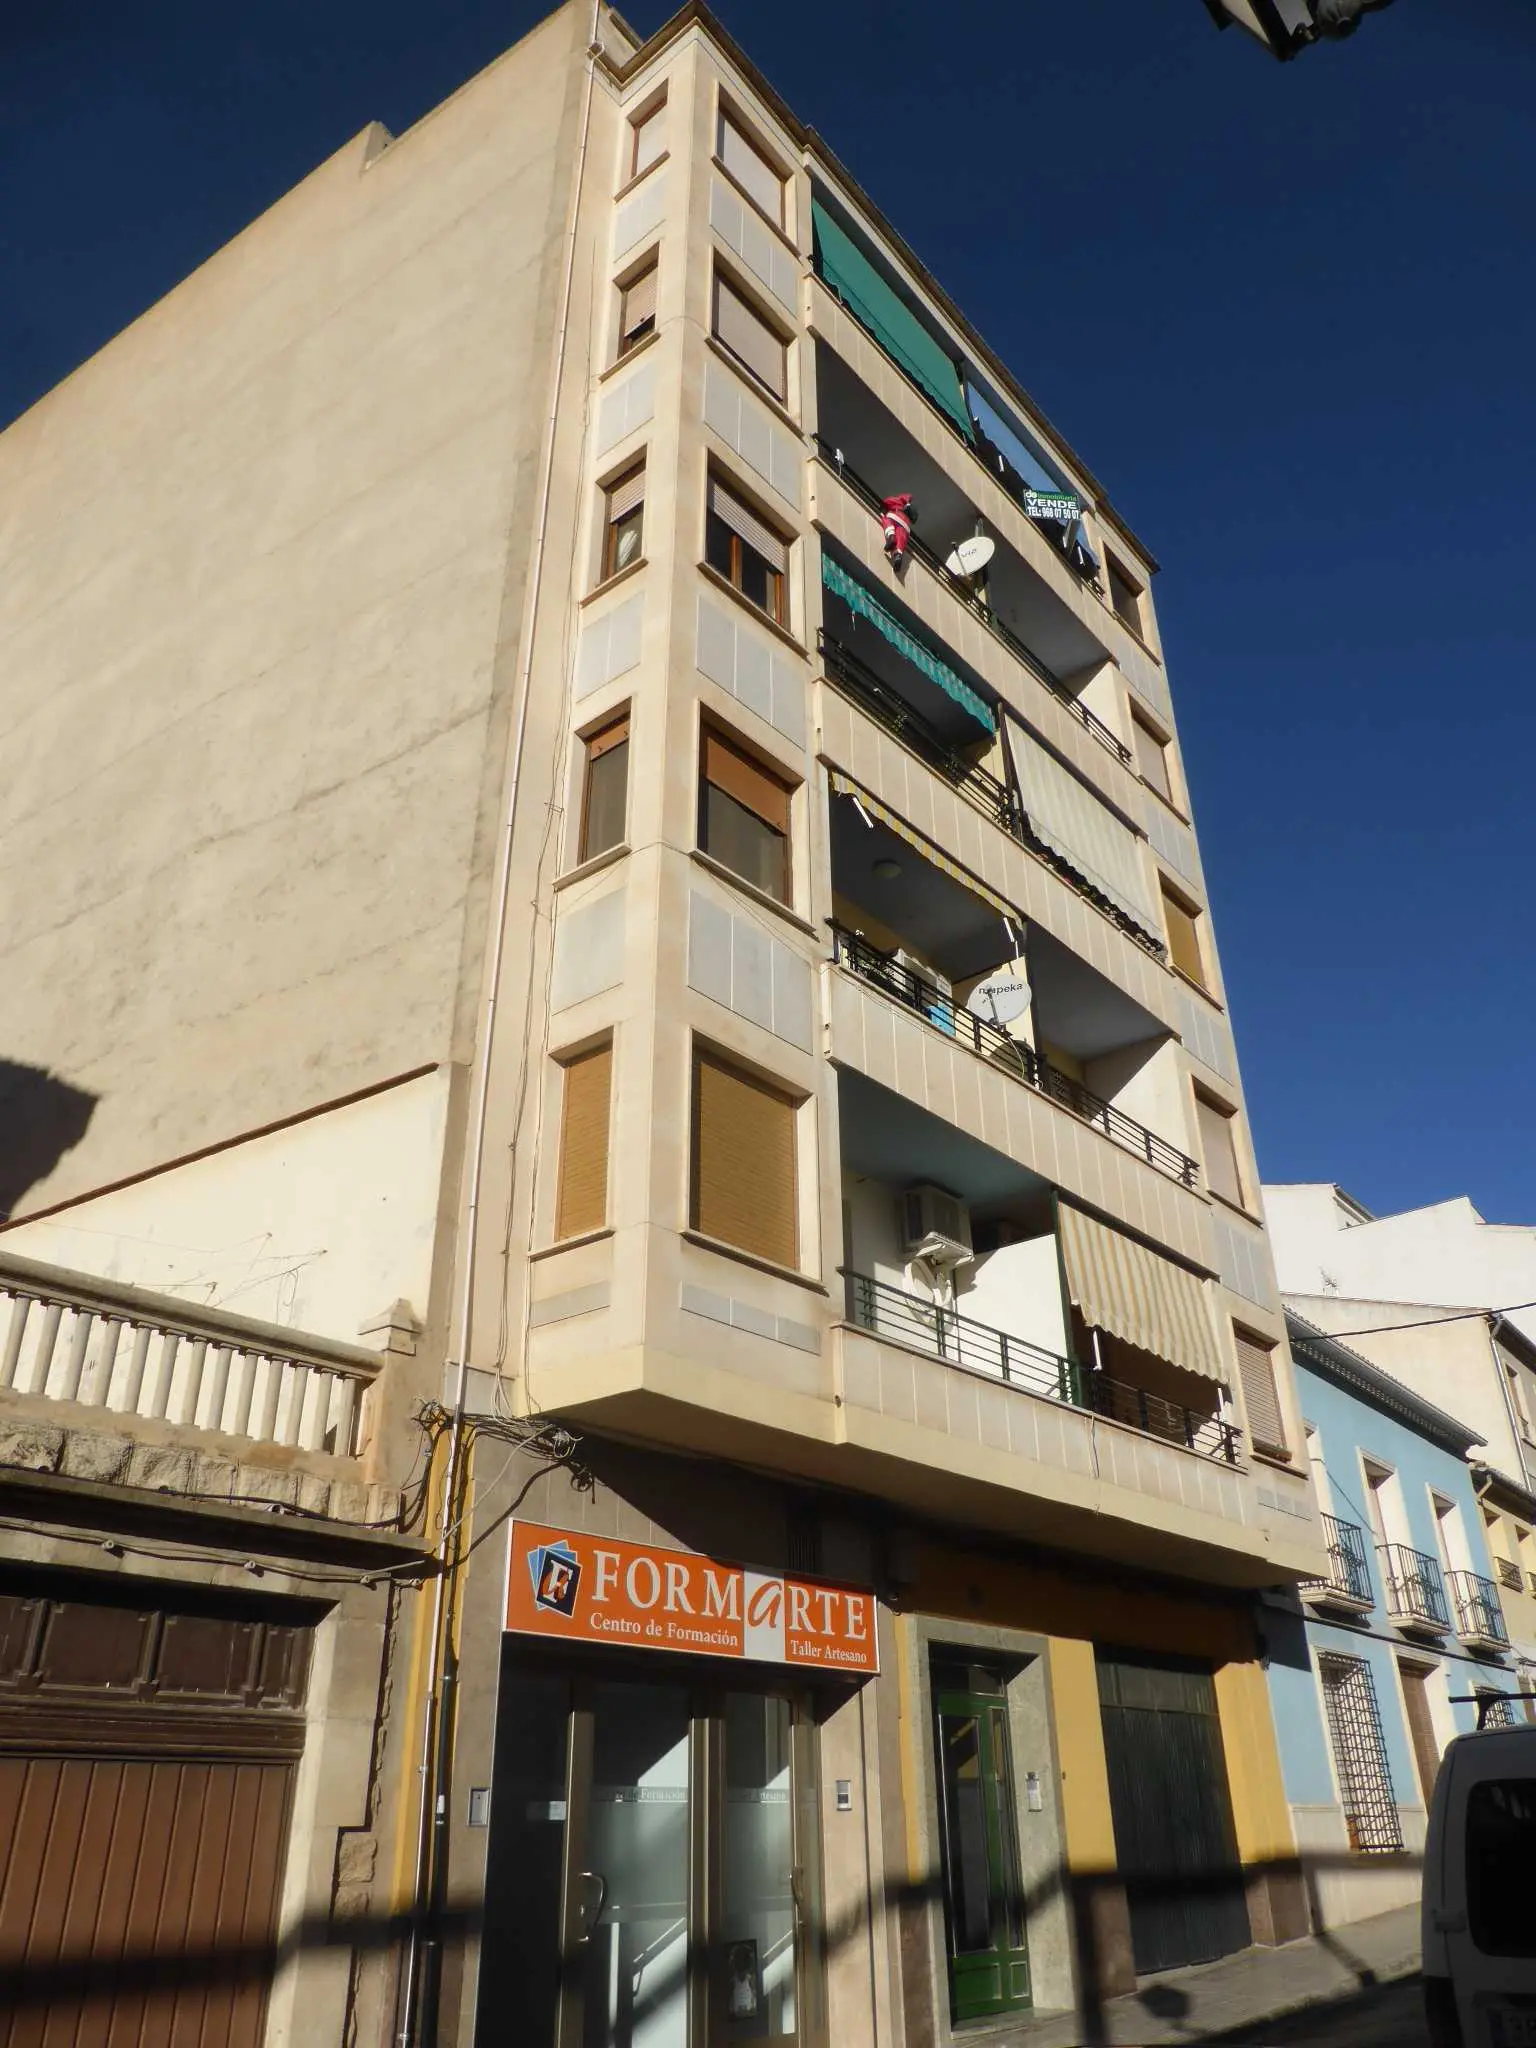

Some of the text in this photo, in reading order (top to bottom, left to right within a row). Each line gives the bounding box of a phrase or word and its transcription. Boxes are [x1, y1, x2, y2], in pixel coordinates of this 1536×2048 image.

[1027, 498, 1077, 509] VENDE
[1027, 506, 1042, 517] TEL:
[590, 1611, 738, 1647] Centro de Formación
[790, 1639, 867, 1664] Taller Artesano
